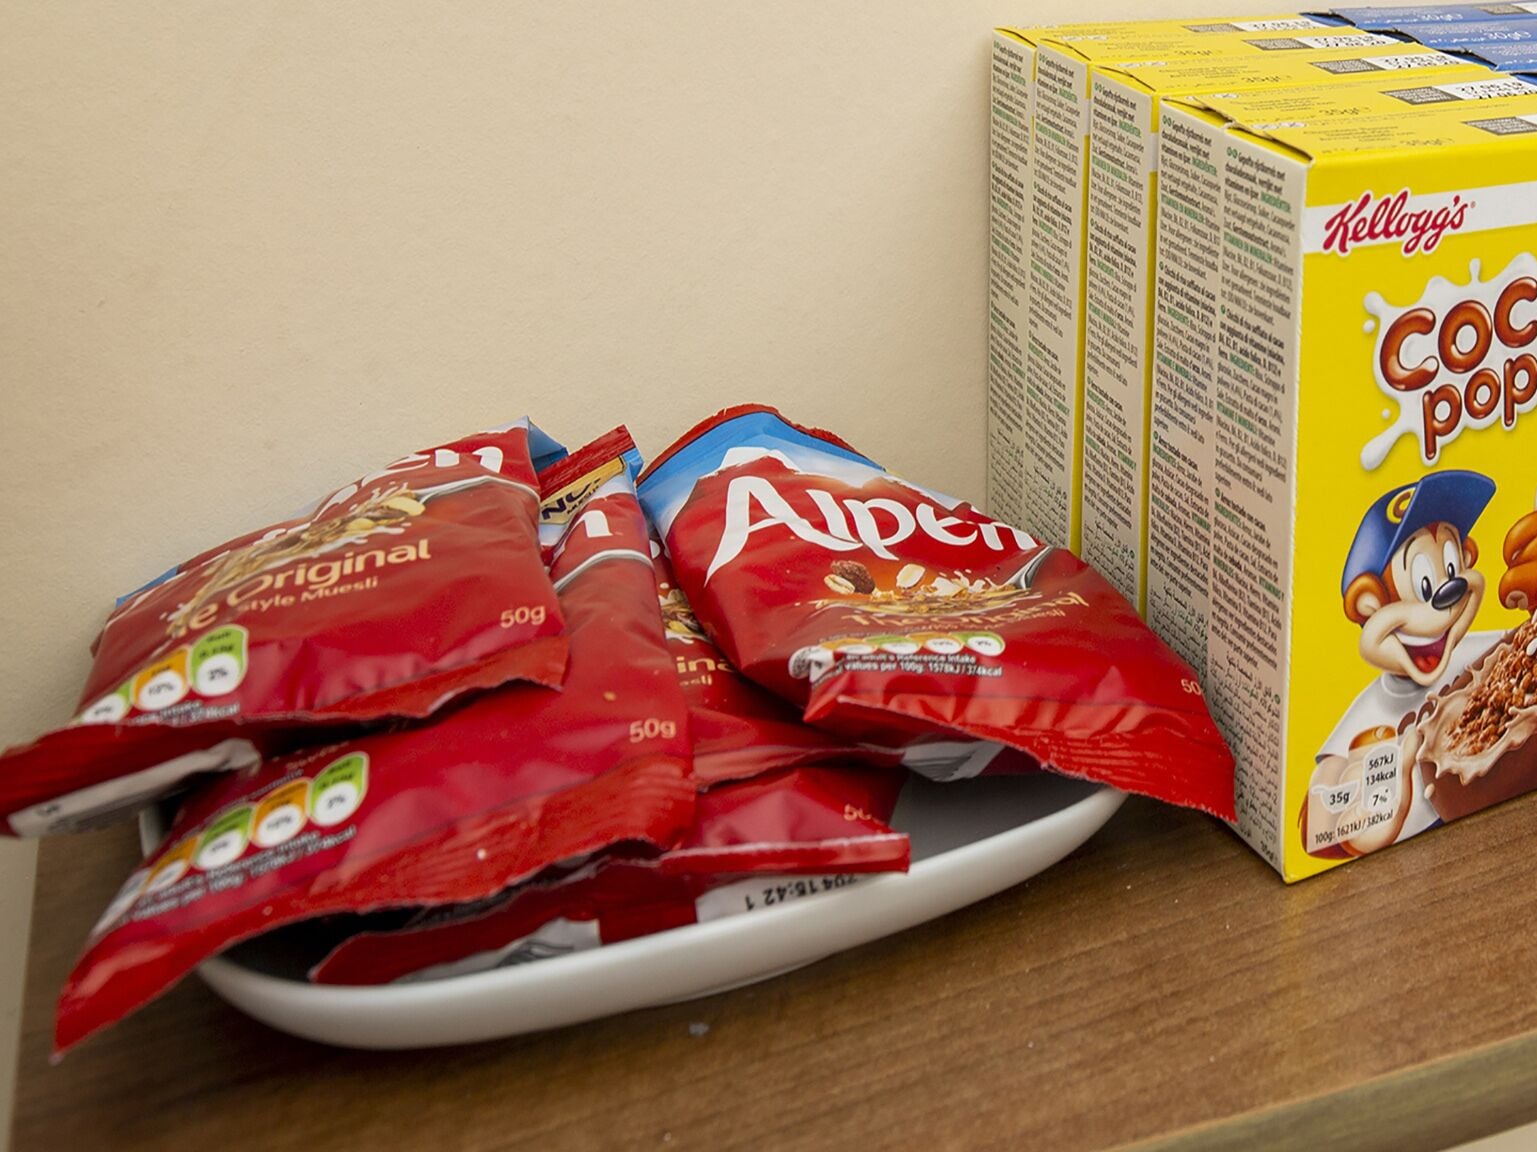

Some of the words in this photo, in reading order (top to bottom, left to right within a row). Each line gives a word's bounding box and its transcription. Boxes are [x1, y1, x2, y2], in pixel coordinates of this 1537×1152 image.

[1323, 189, 1470, 258] Kellogg's
[706, 474, 1038, 587] Alpen
[227, 539, 432, 608] Original
[300, 575, 379, 602] Muesli
[499, 602, 547, 628] 50g
[844, 661, 879, 674] values
[880, 662, 898, 675] per
[628, 718, 677, 745] 50g
[1366, 767, 1398, 786] 134kcal
[1329, 791, 1351, 806] 35g
